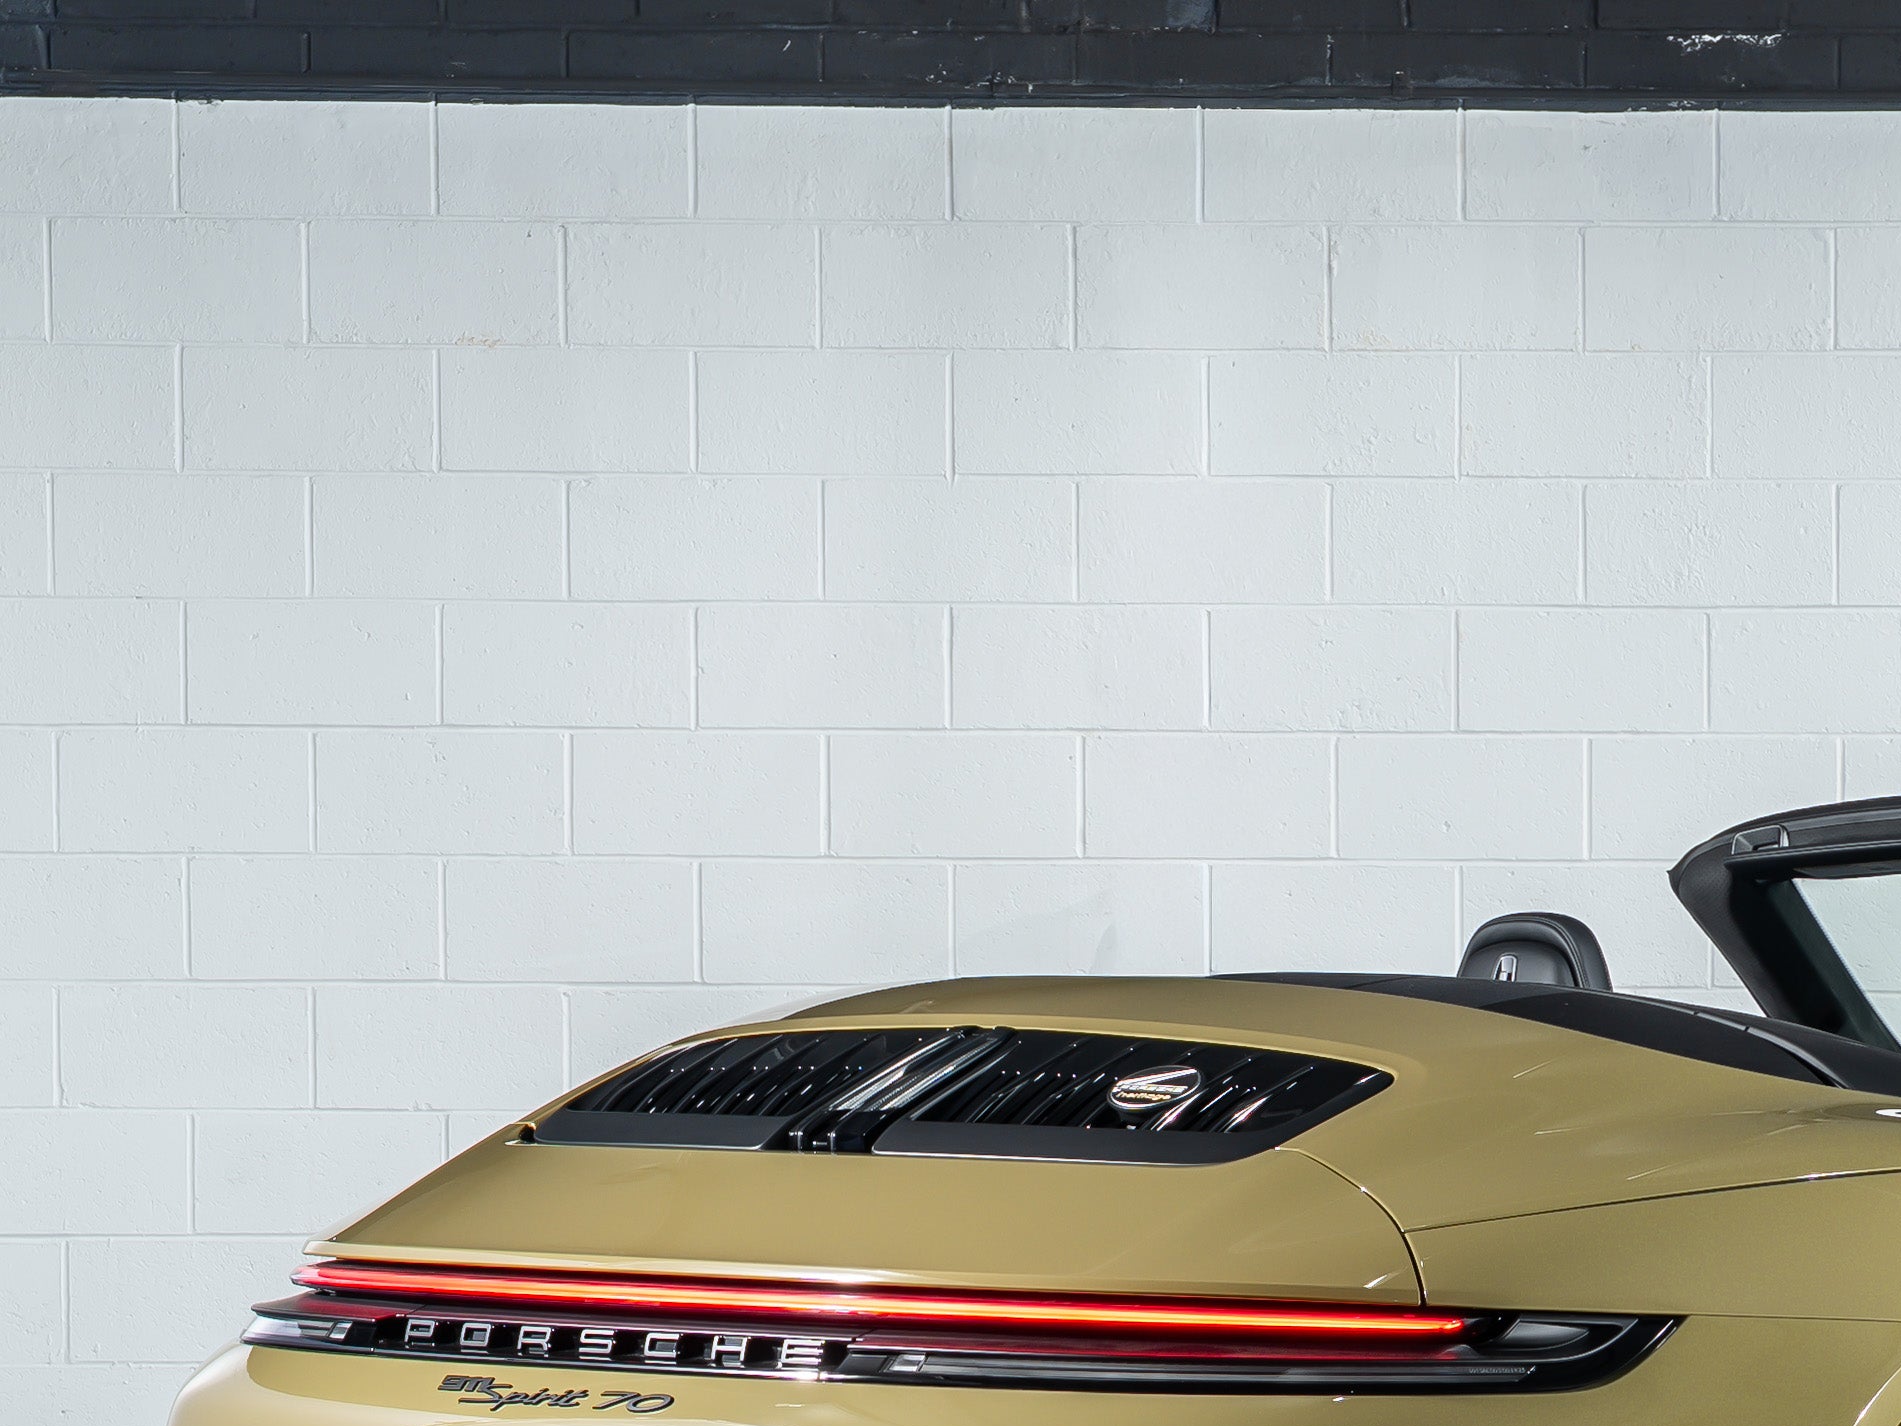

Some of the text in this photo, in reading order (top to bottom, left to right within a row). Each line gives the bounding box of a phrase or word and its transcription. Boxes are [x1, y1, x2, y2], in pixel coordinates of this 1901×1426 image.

[404, 1319, 826, 1365] PORSCHE
[458, 1384, 590, 1412] Spirit
[592, 1391, 675, 1413] 70
